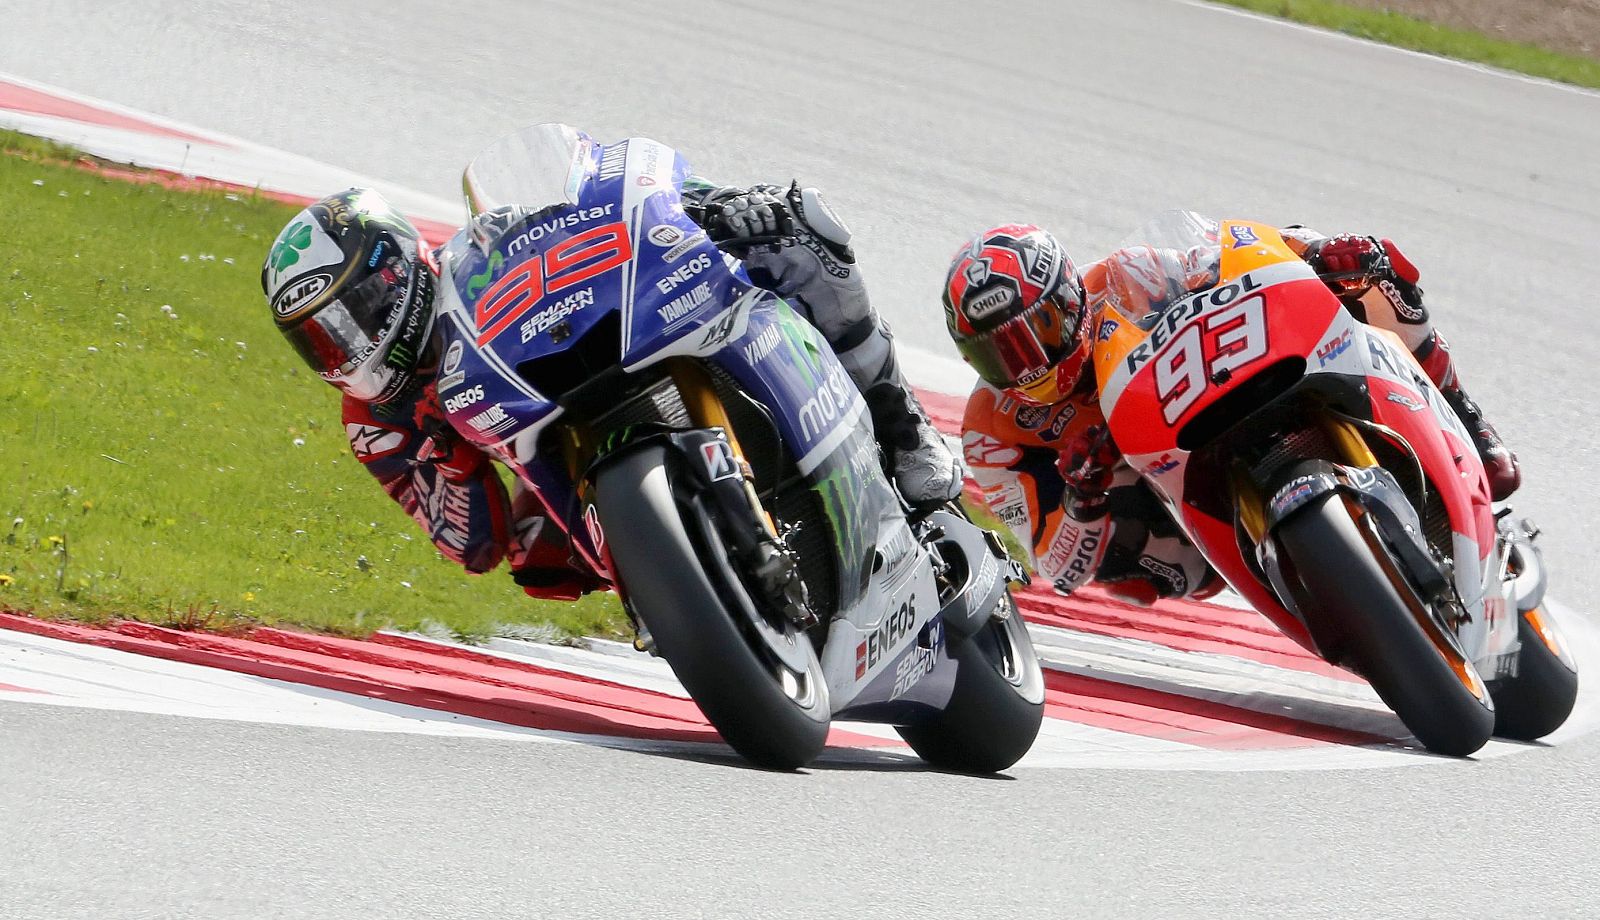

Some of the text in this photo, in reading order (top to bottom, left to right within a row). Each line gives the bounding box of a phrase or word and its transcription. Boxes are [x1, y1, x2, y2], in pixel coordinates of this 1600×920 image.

[507, 202, 615, 257] movistar
[280, 278, 321, 312] HJC
[475, 221, 633, 348] 99
[656, 253, 712, 295] ENEOS
[520, 287, 594, 333] SEMAKIN
[521, 298, 594, 345] DI DEPAN
[657, 280, 713, 323] YAMALUBE
[972, 290, 1008, 313] SHOEI
[744, 323, 782, 367] YAMAHA
[1126, 273, 1263, 376] REPSOL
[351, 328, 388, 367] SECTOR
[1154, 292, 1270, 427] 93
[1018, 366, 1049, 387] LOTUS
[444, 384, 485, 414] ENEOS
[1052, 406, 1075, 436] GAS
[1053, 527, 1102, 595] REPSOL
[866, 593, 916, 671] ENEOS
